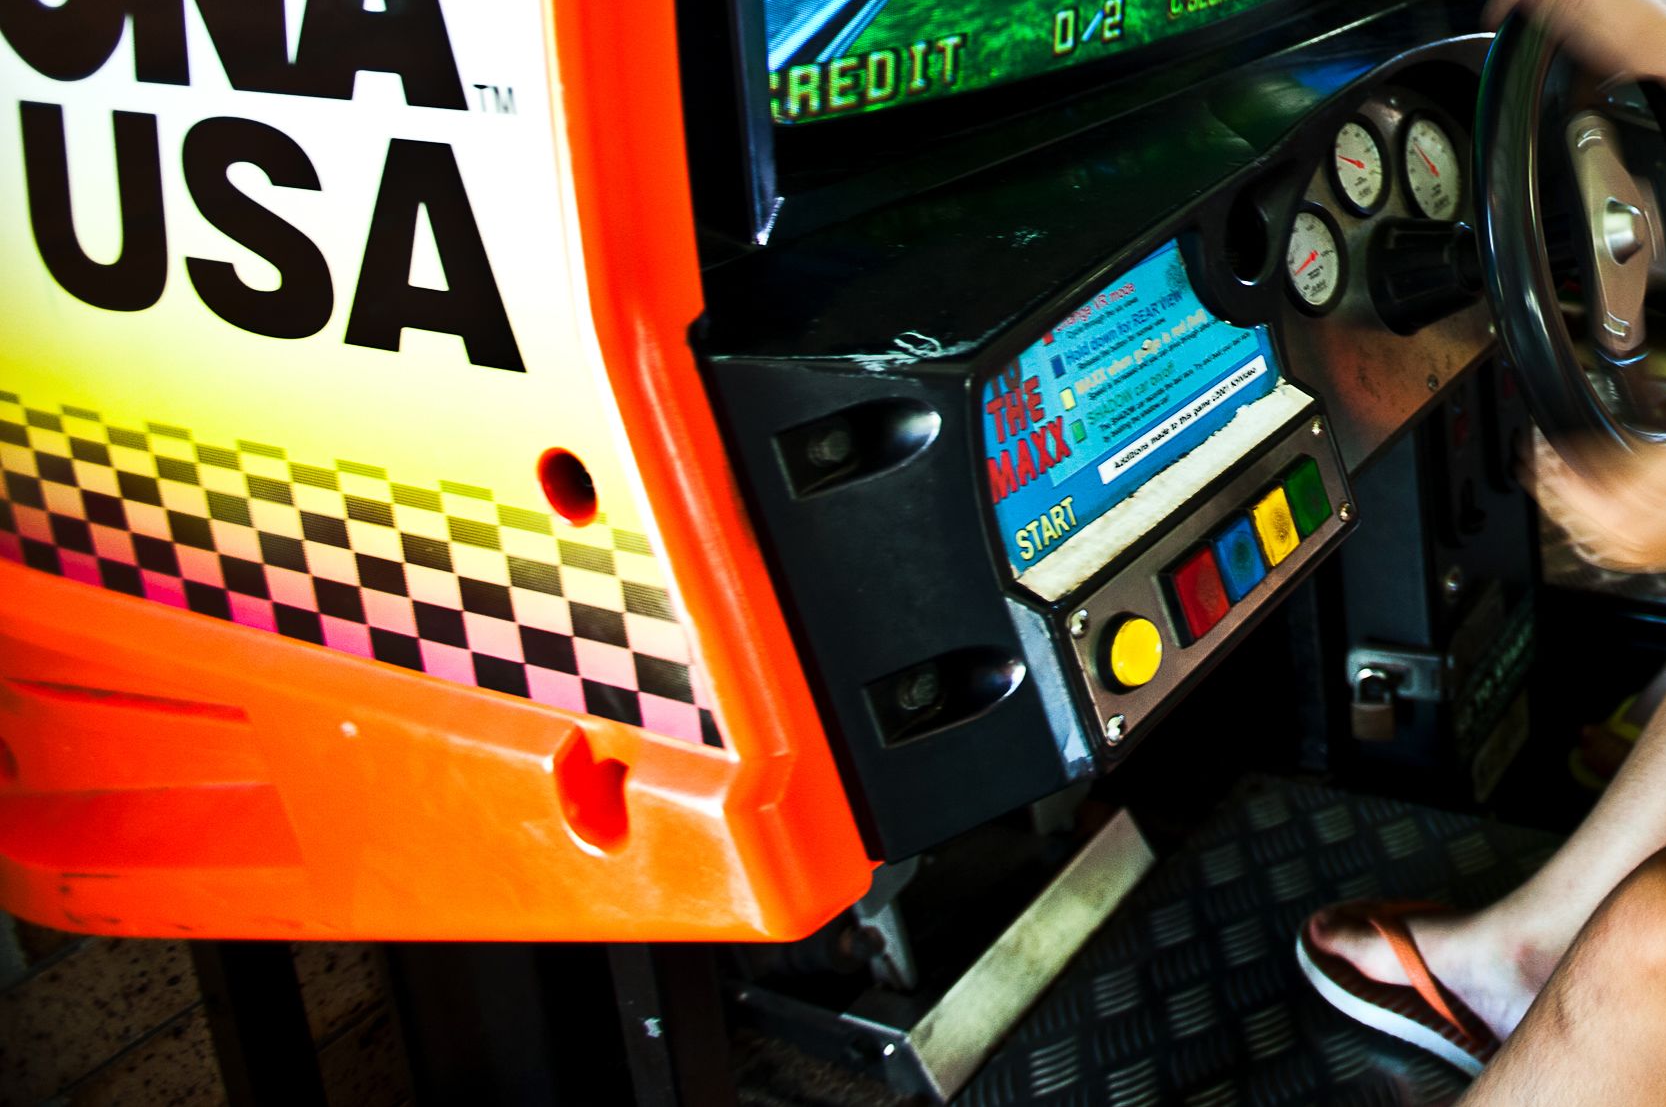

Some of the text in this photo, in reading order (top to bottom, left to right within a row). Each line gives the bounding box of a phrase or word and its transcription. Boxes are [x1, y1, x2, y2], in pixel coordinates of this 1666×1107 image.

[19, 100, 527, 374] USA
[985, 375, 1045, 444] THE
[986, 415, 1072, 504] MAXX
[1015, 496, 1077, 561] START
